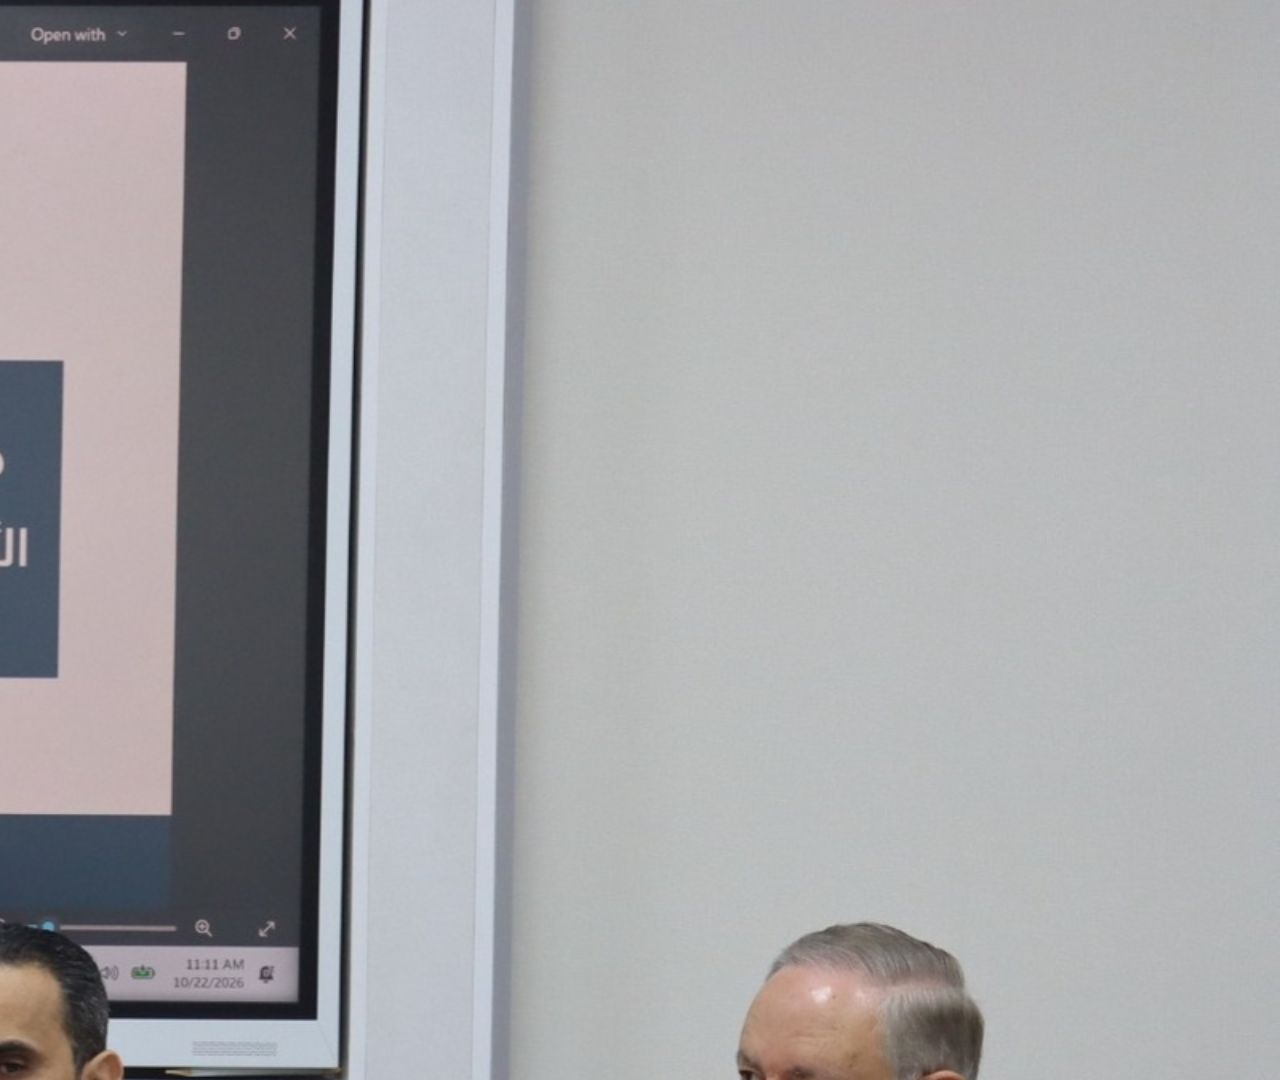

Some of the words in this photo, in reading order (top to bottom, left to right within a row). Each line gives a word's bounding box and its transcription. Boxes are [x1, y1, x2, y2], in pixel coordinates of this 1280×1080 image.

[30, 26, 71, 45] Open
[74, 27, 106, 41] with
[187, 958, 219, 970] 11:11
[222, 958, 245, 970] AM
